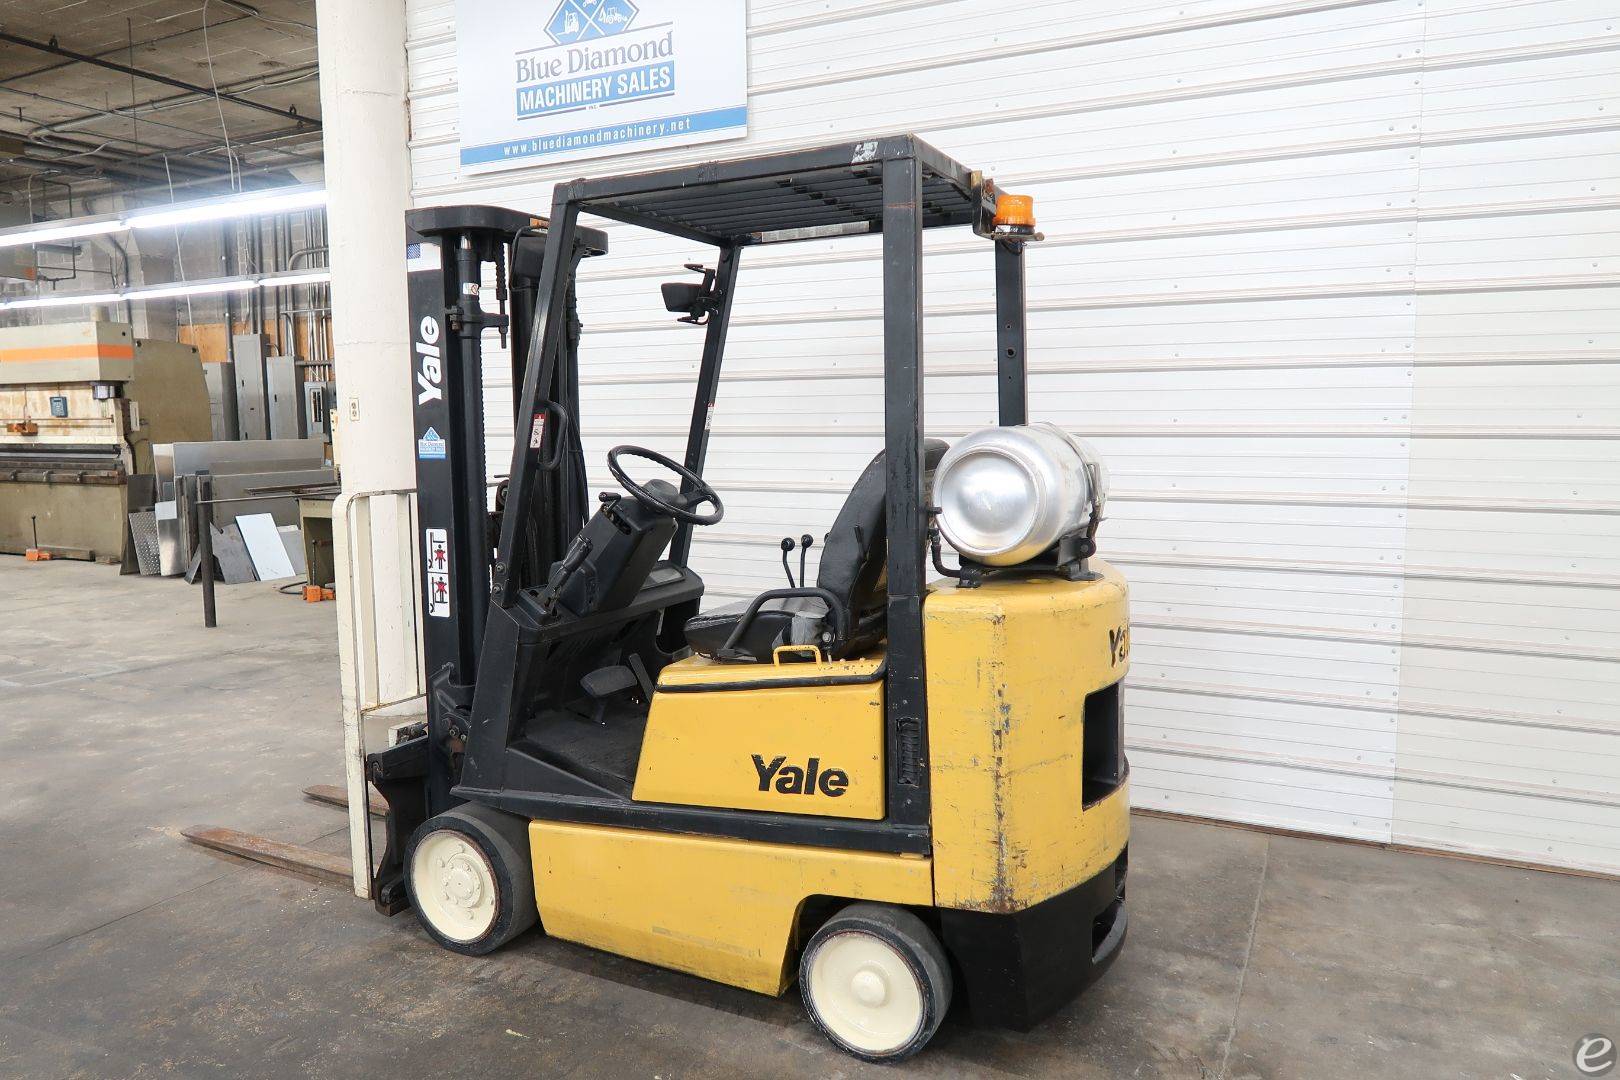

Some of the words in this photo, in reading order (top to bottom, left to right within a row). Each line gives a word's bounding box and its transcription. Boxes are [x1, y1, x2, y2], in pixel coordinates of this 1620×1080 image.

[516, 57, 562, 83] Blue
[568, 31, 673, 74] Diamond
[520, 76, 613, 111] MACHINERY
[617, 66, 670, 95] SALES
[503, 117, 691, 156] www.bluediamondmachinery.net
[415, 315, 442, 405] Yale
[751, 754, 849, 797] Yale
